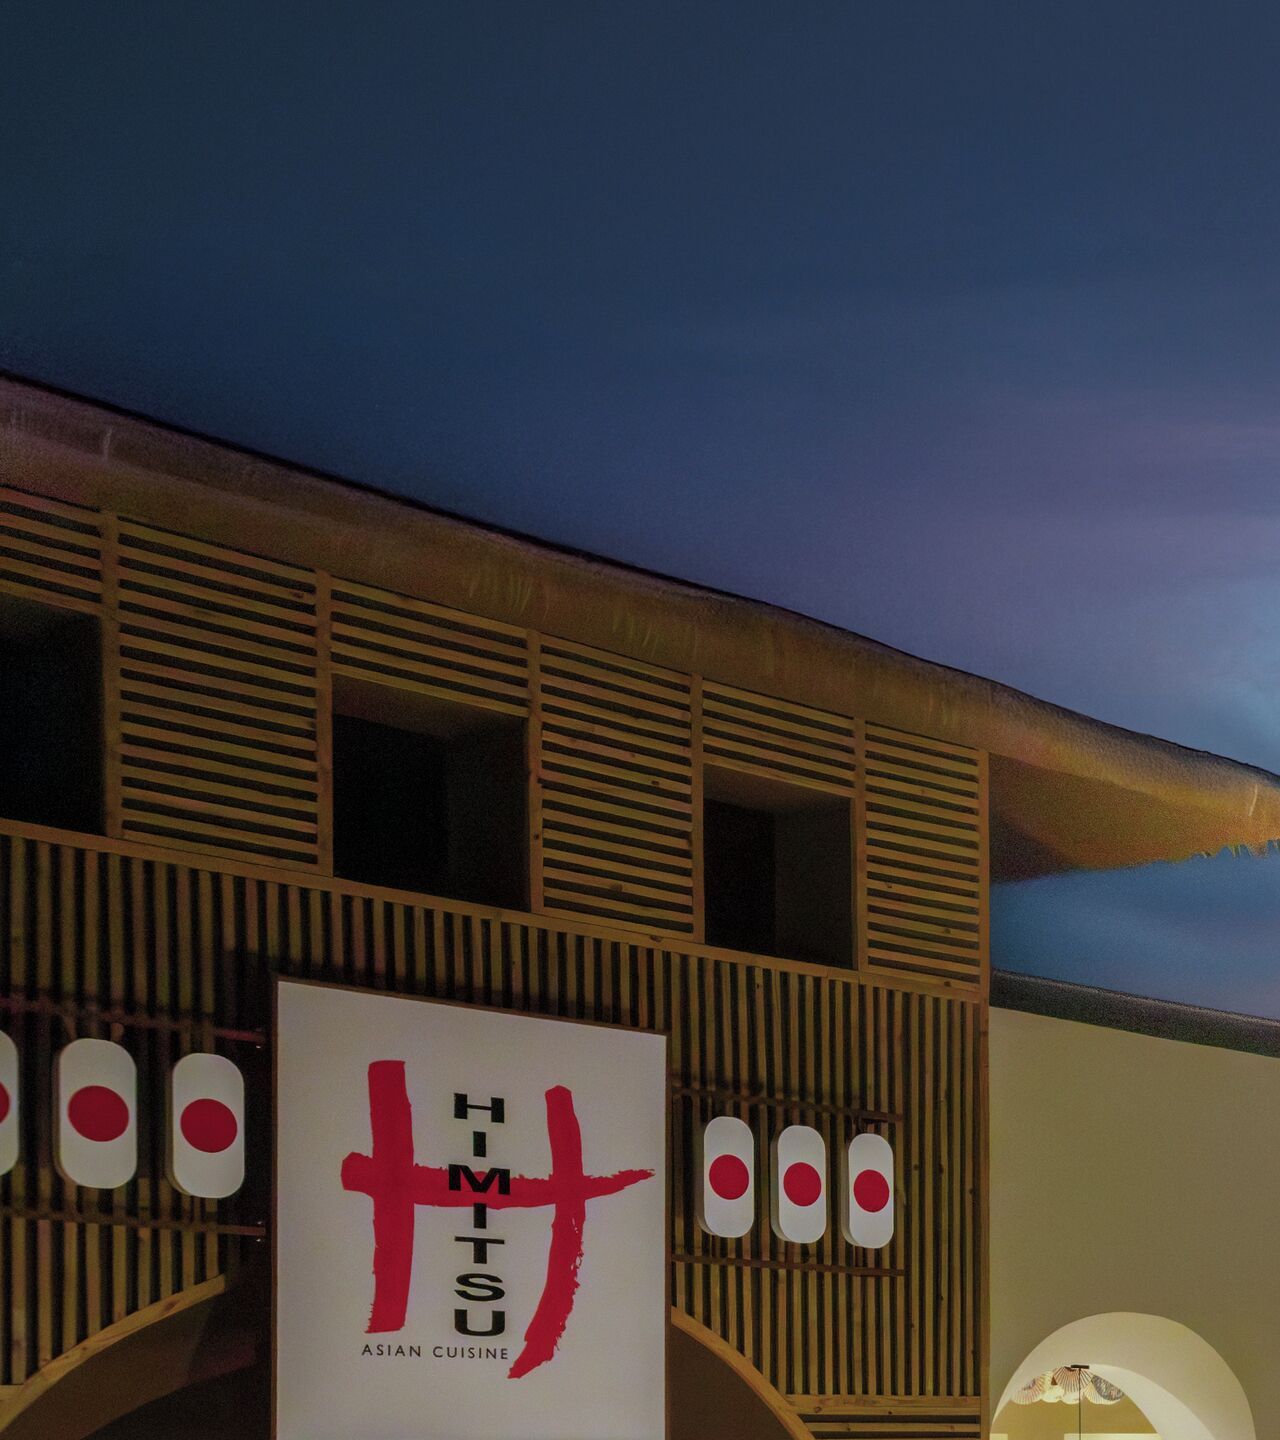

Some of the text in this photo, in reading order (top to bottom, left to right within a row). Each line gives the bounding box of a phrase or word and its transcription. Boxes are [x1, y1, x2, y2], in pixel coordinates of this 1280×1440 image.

[447, 1092, 511, 1337] HIMITSU
[361, 1343, 509, 1360] ASIAN CUISINE
